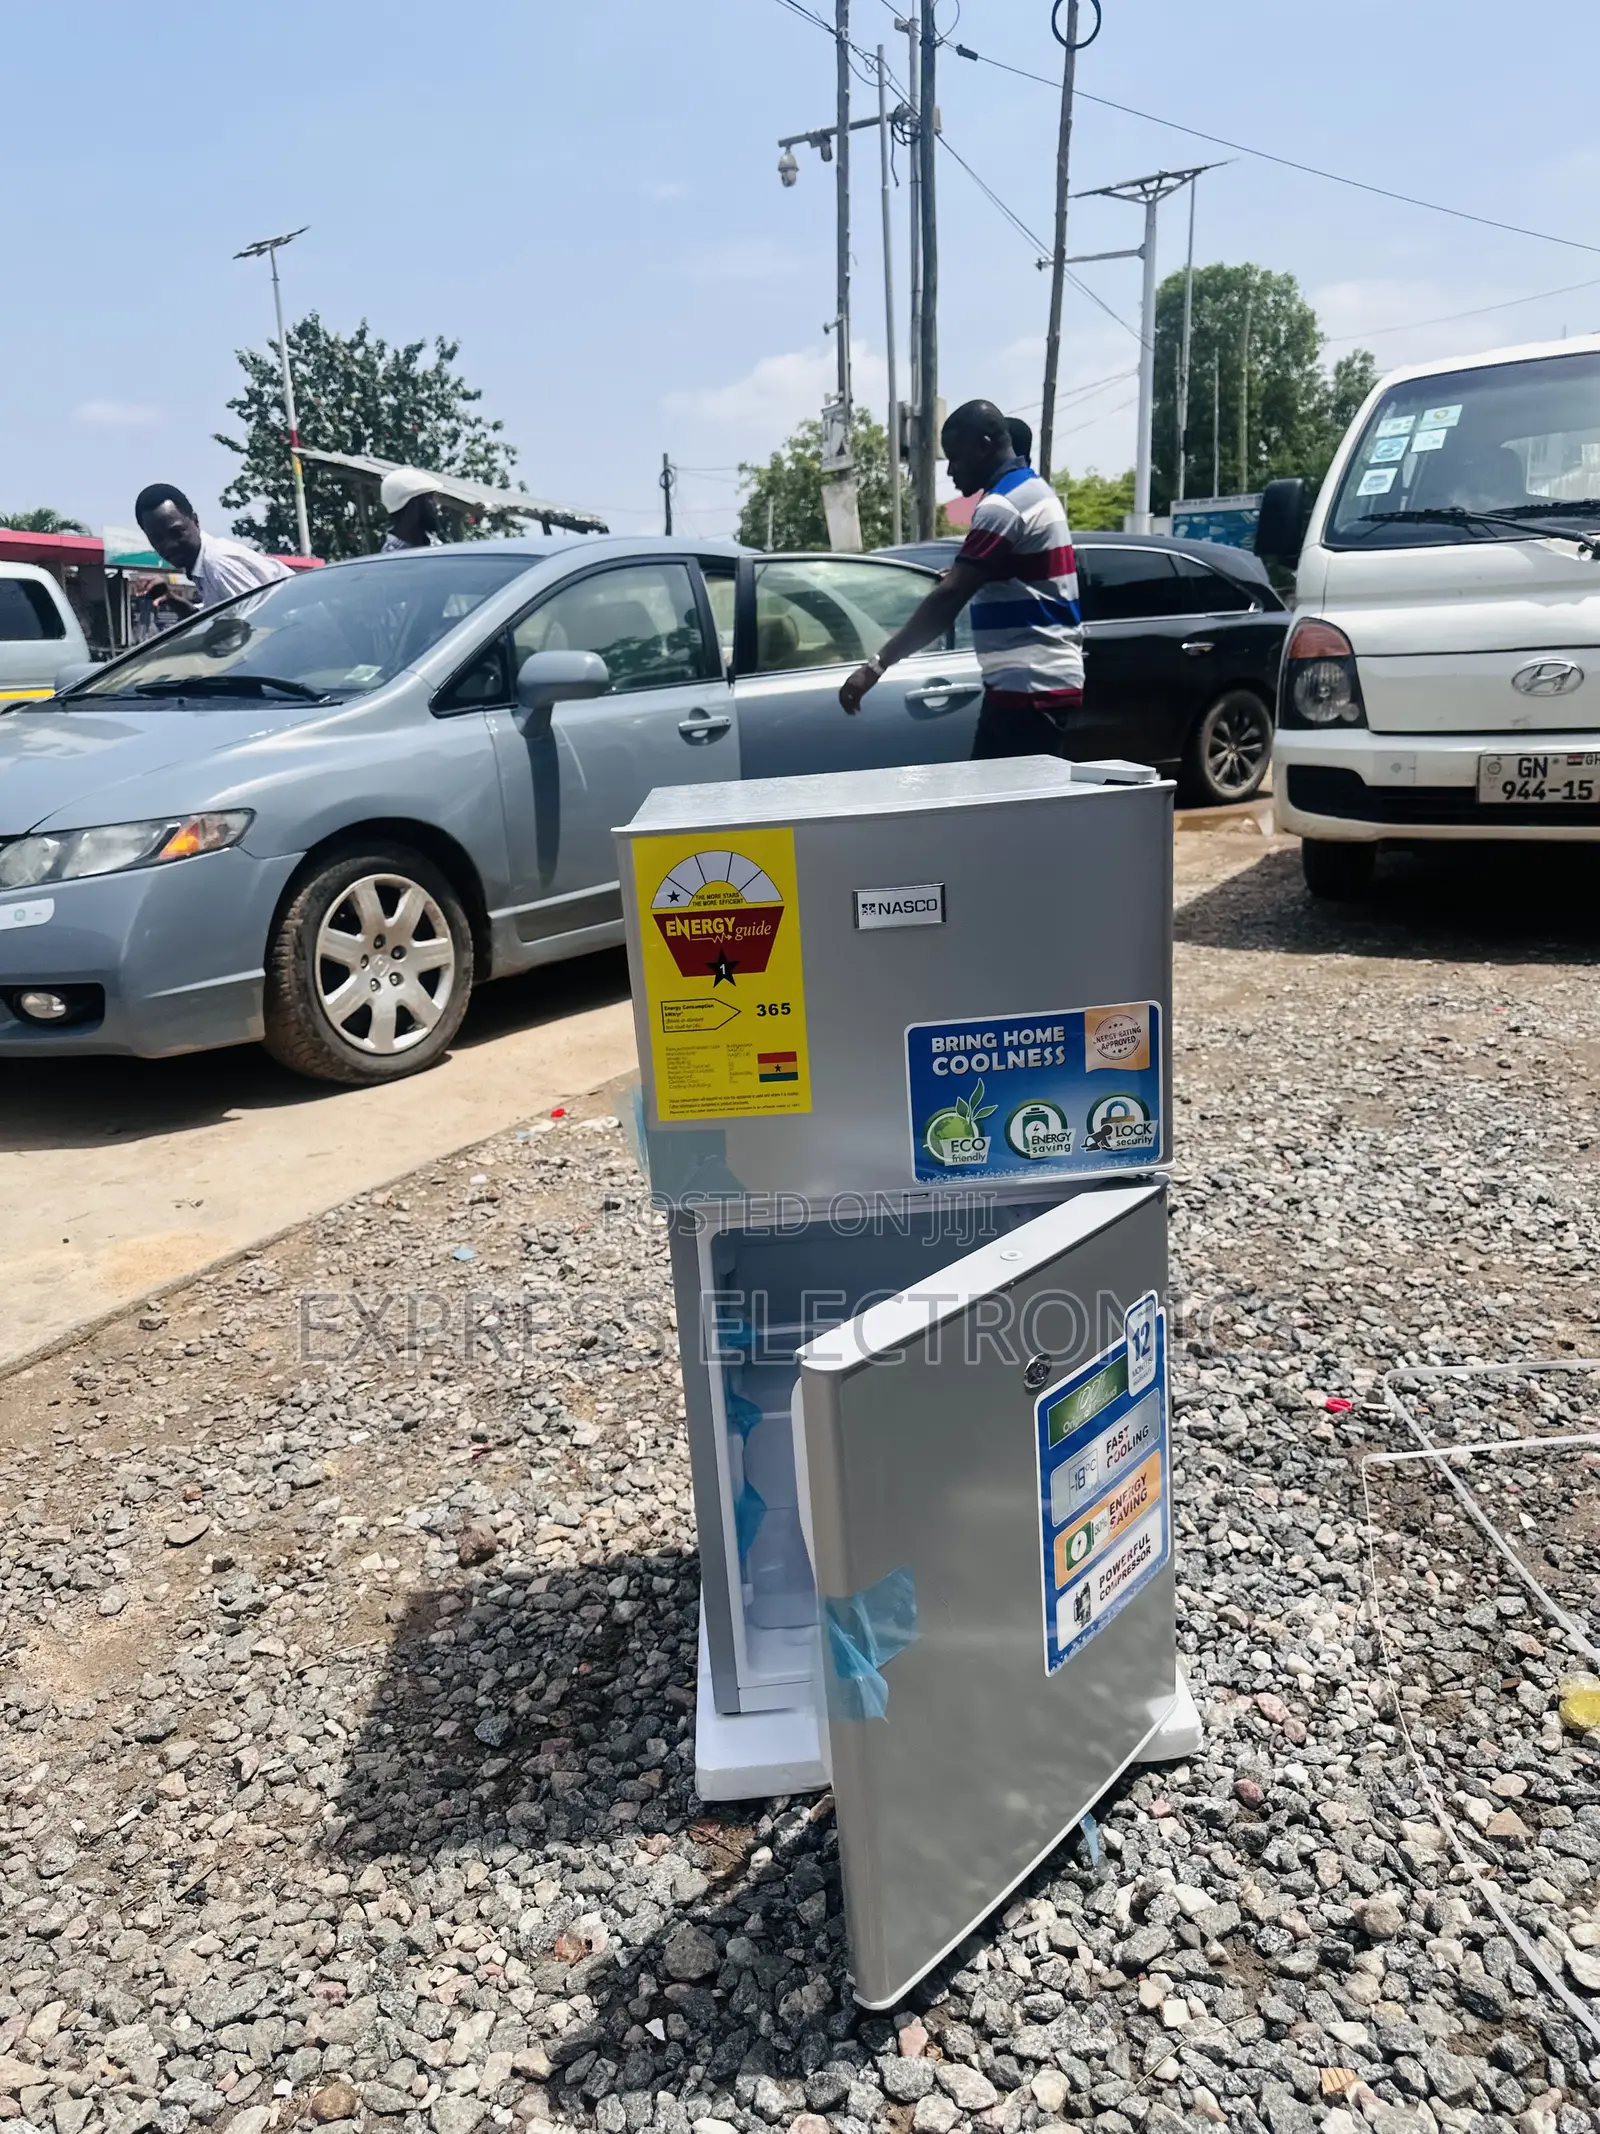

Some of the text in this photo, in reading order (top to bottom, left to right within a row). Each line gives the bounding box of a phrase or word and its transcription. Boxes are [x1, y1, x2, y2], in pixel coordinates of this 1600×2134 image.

[1518, 757, 1548, 778] GN
[1502, 780, 1594, 800] 944-15
[878, 899, 938, 915] NASCO
[665, 915, 772, 942] ENERGY guide
[720, 964, 726, 975] 1
[756, 1002, 792, 1018] 365
[931, 1025, 1066, 1053] BRING HOME
[1101, 1035, 1136, 1050] APPROVED
[932, 1045, 1066, 1077] COOLNESS
[1031, 1131, 1072, 1145] ENERGY
[1115, 1122, 1153, 1138] LOCK
[951, 1137, 986, 1153] ECO
[1032, 1142, 1071, 1154] saving
[1116, 1135, 1154, 1147] security
[952, 1152, 987, 1164] friendly
[1133, 1321, 1151, 1362] 12
[1106, 1425, 1130, 1455] FAST
[1107, 1425, 1149, 1469] COOLING
[1109, 1472, 1148, 1516] ENERGY
[1109, 1488, 1148, 1530] SAVING
[1099, 1532, 1151, 1589] POWERFUL
[1099, 1545, 1152, 1602] COMPRESSOR
